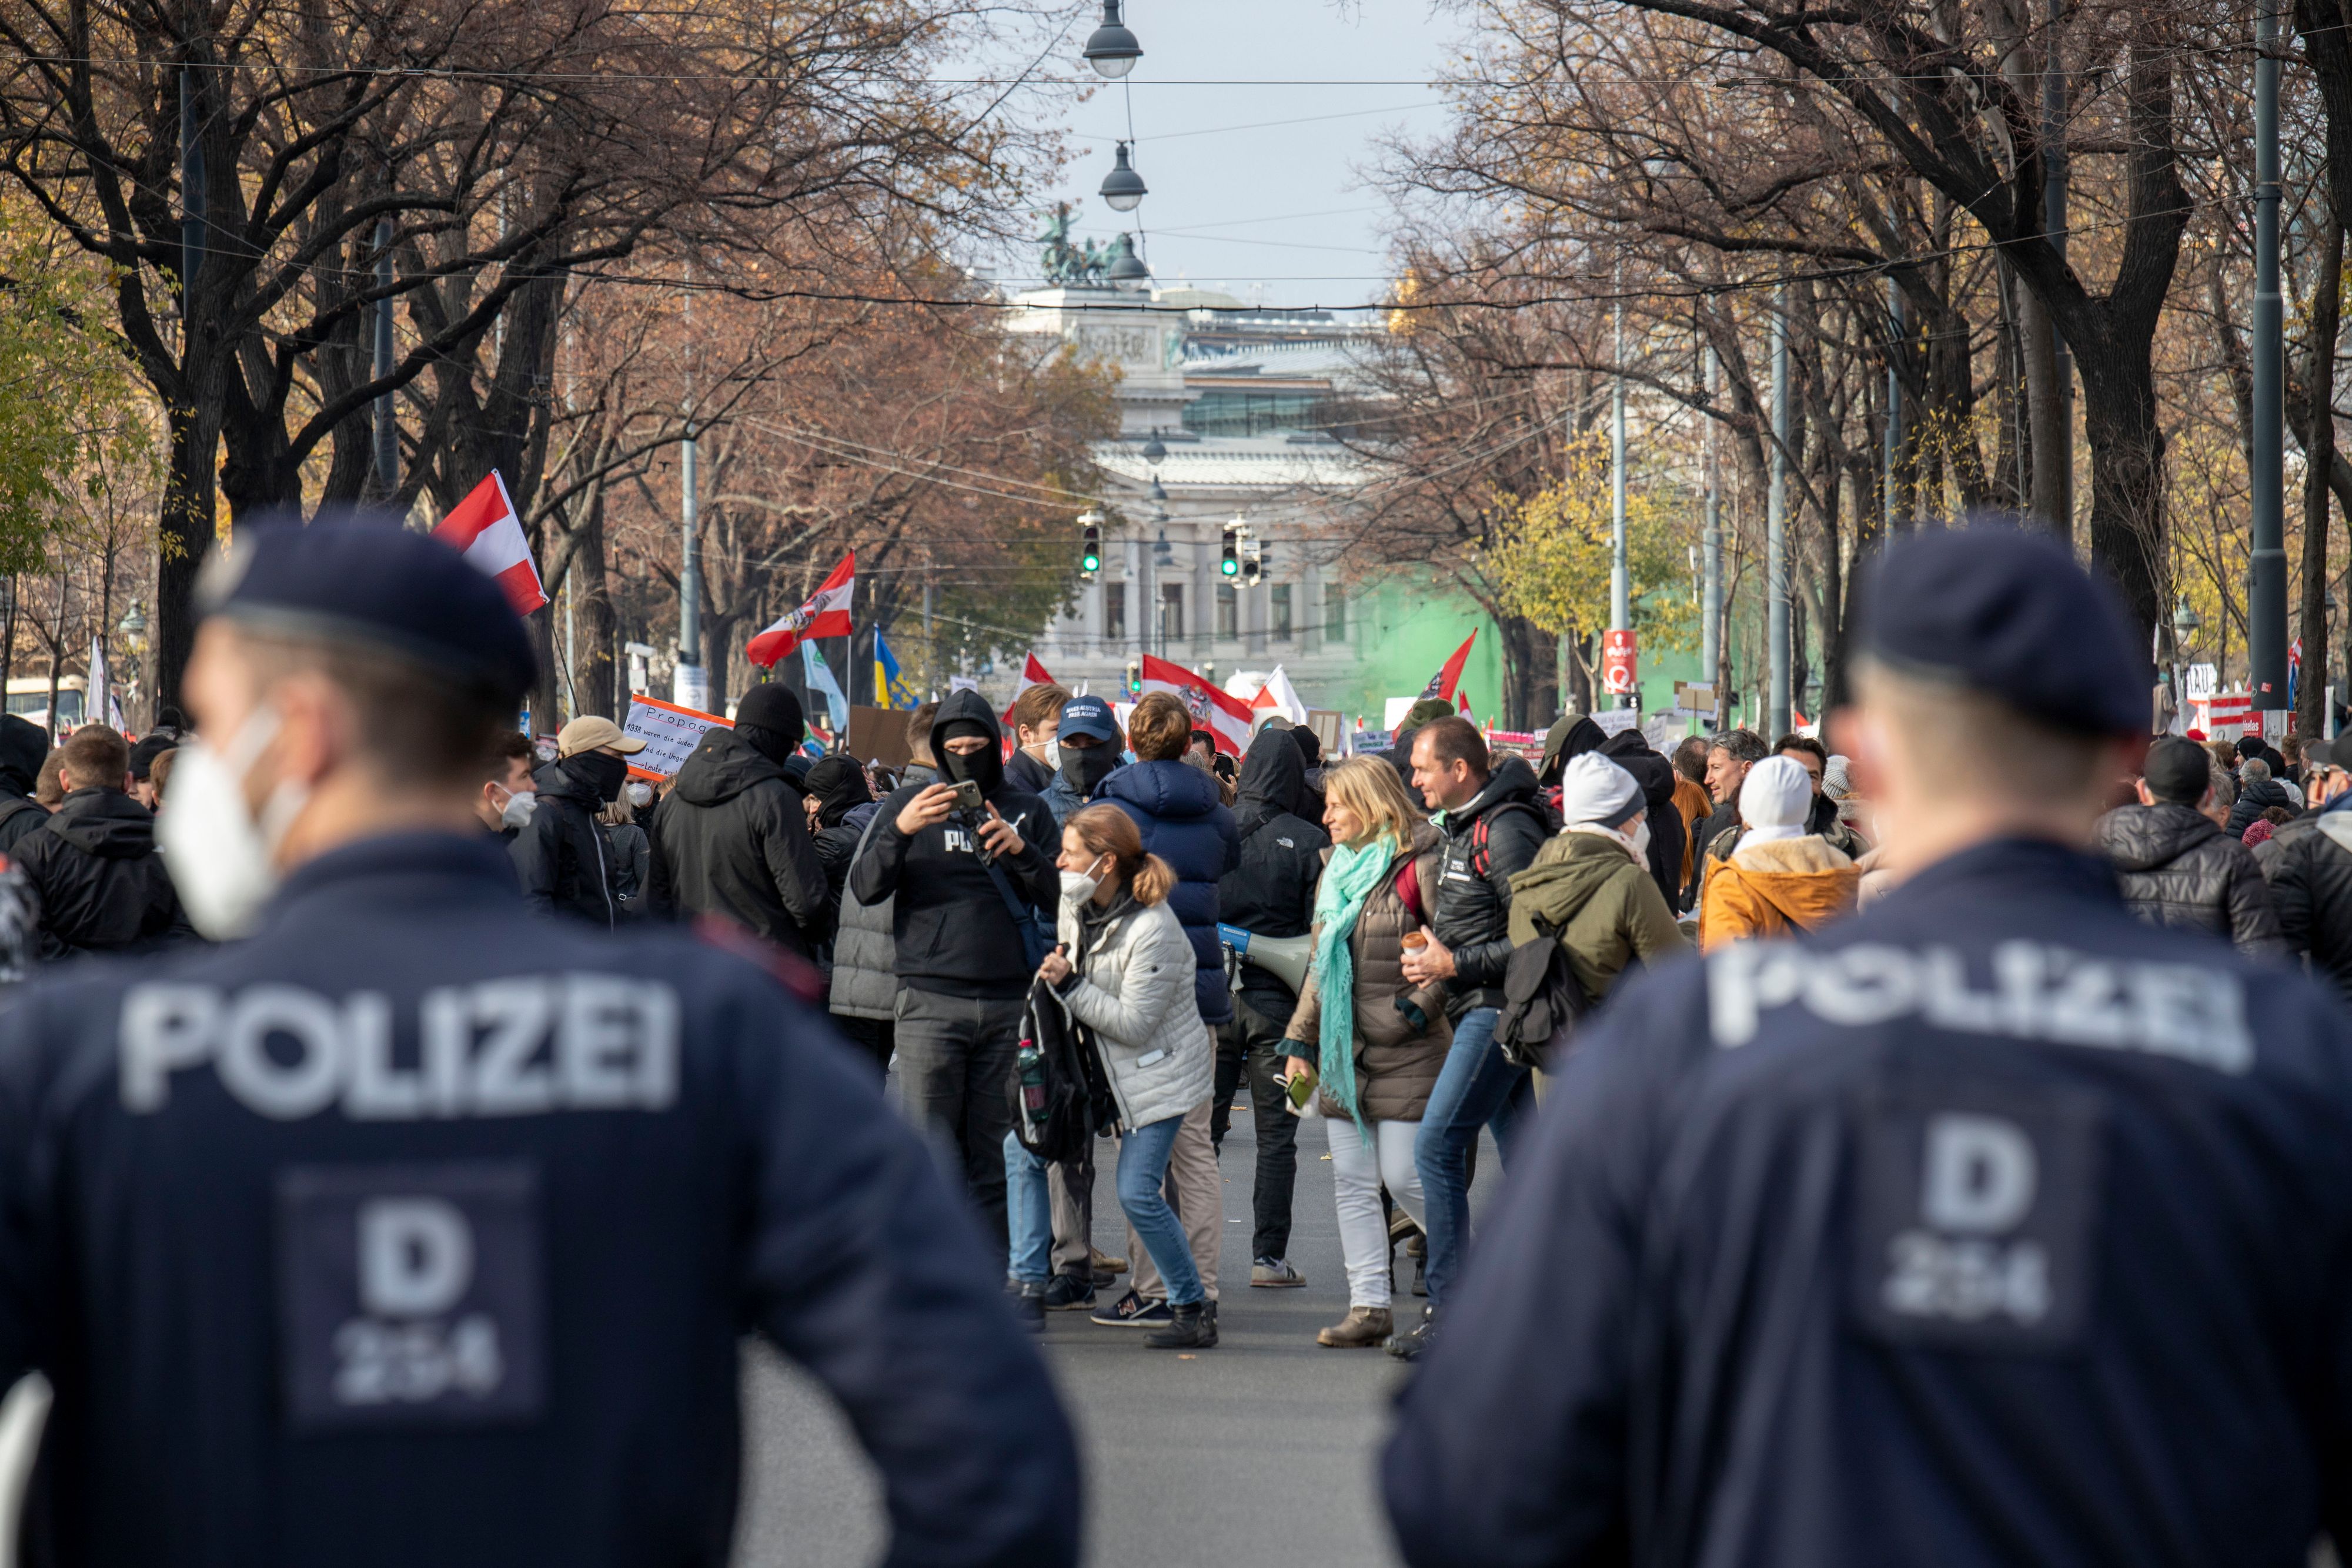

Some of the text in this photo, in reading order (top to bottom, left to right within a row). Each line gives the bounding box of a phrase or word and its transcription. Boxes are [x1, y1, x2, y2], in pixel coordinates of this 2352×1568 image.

[626, 723, 642, 733] 1938
[643, 730, 660, 739] waren
[677, 738, 694, 748] Juden
[647, 707, 706, 734] Propag
[669, 753, 688, 763] Ungei
[644, 762, 662, 773] Leute
[944, 830, 974, 852] PU
[121, 974, 680, 1118] POLIZEI
[1707, 940, 2254, 1076] POLIZEI
[1924, 1110, 2037, 1233] D
[359, 1196, 470, 1316] D
[1886, 1229, 2050, 1326] 254
[335, 1312, 502, 1403] 254
